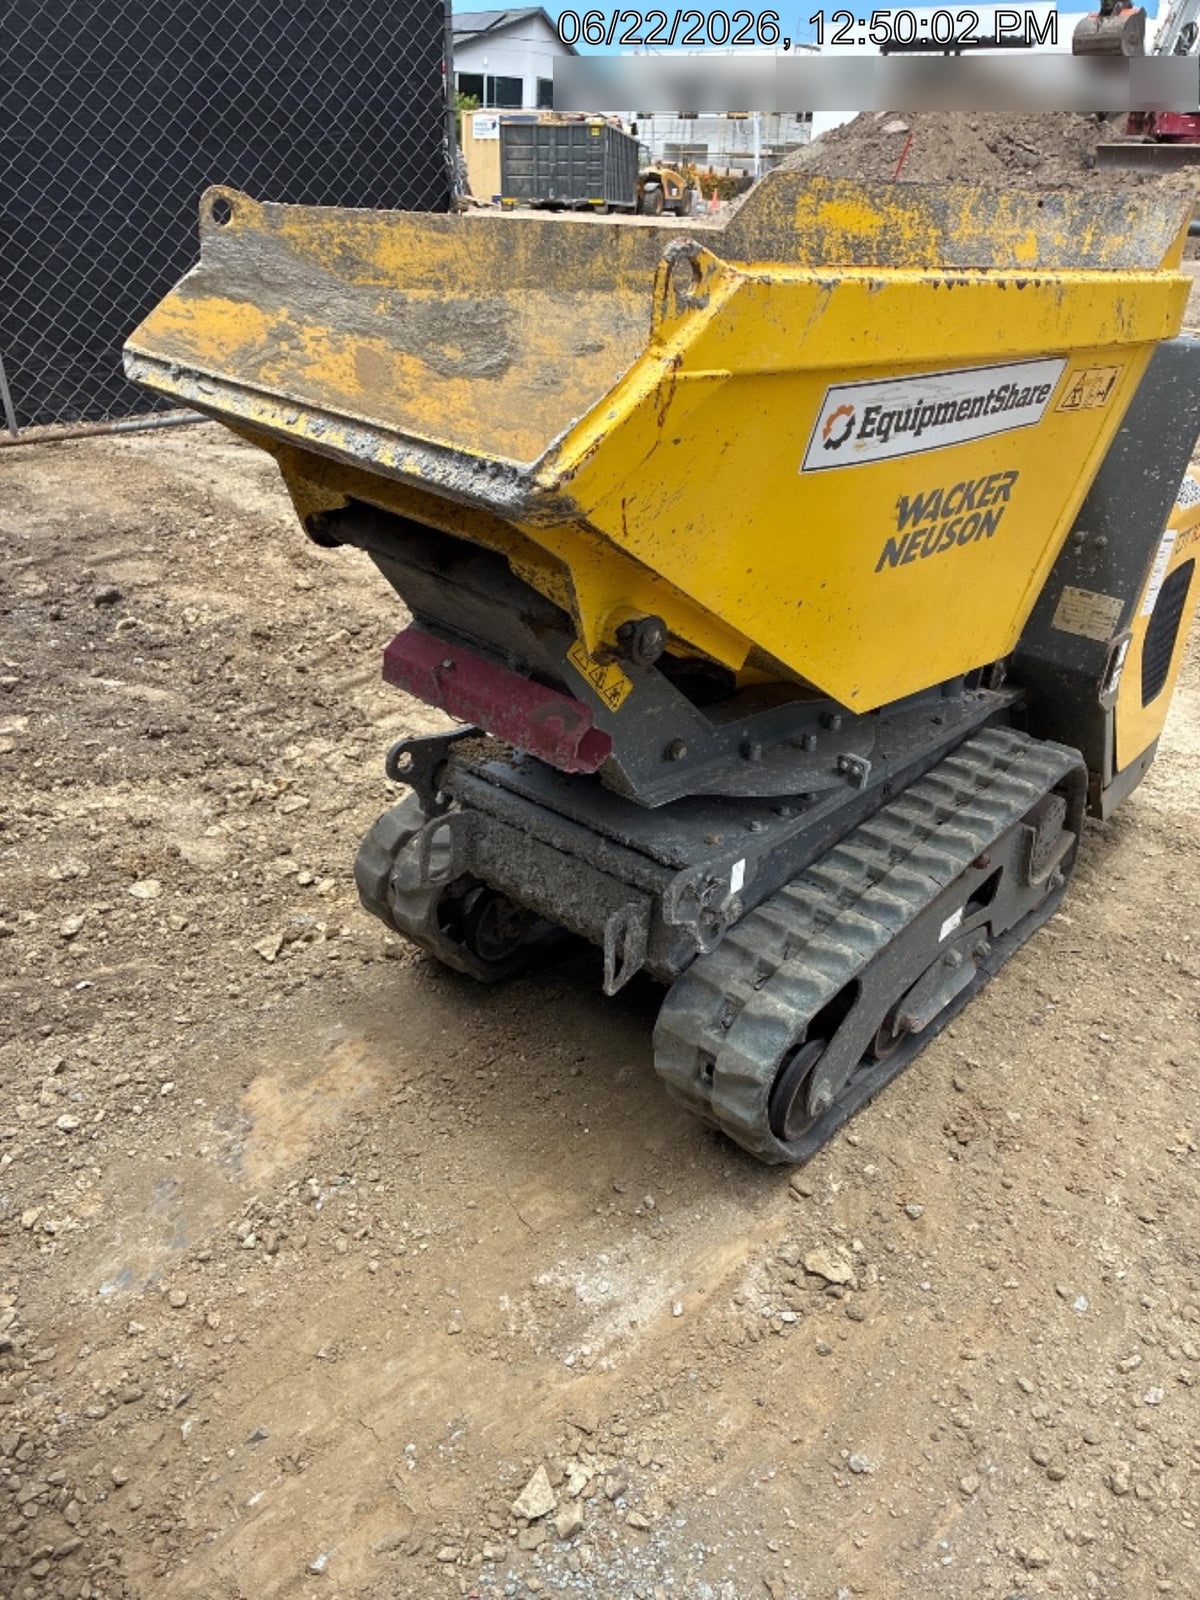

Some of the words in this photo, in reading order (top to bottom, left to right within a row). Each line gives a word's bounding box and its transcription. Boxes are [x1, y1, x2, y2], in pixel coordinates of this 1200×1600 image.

[856, 383, 1051, 442] EquipmentShare
[897, 471, 1019, 531] WACKER
[875, 506, 1006, 572] NEUSON
